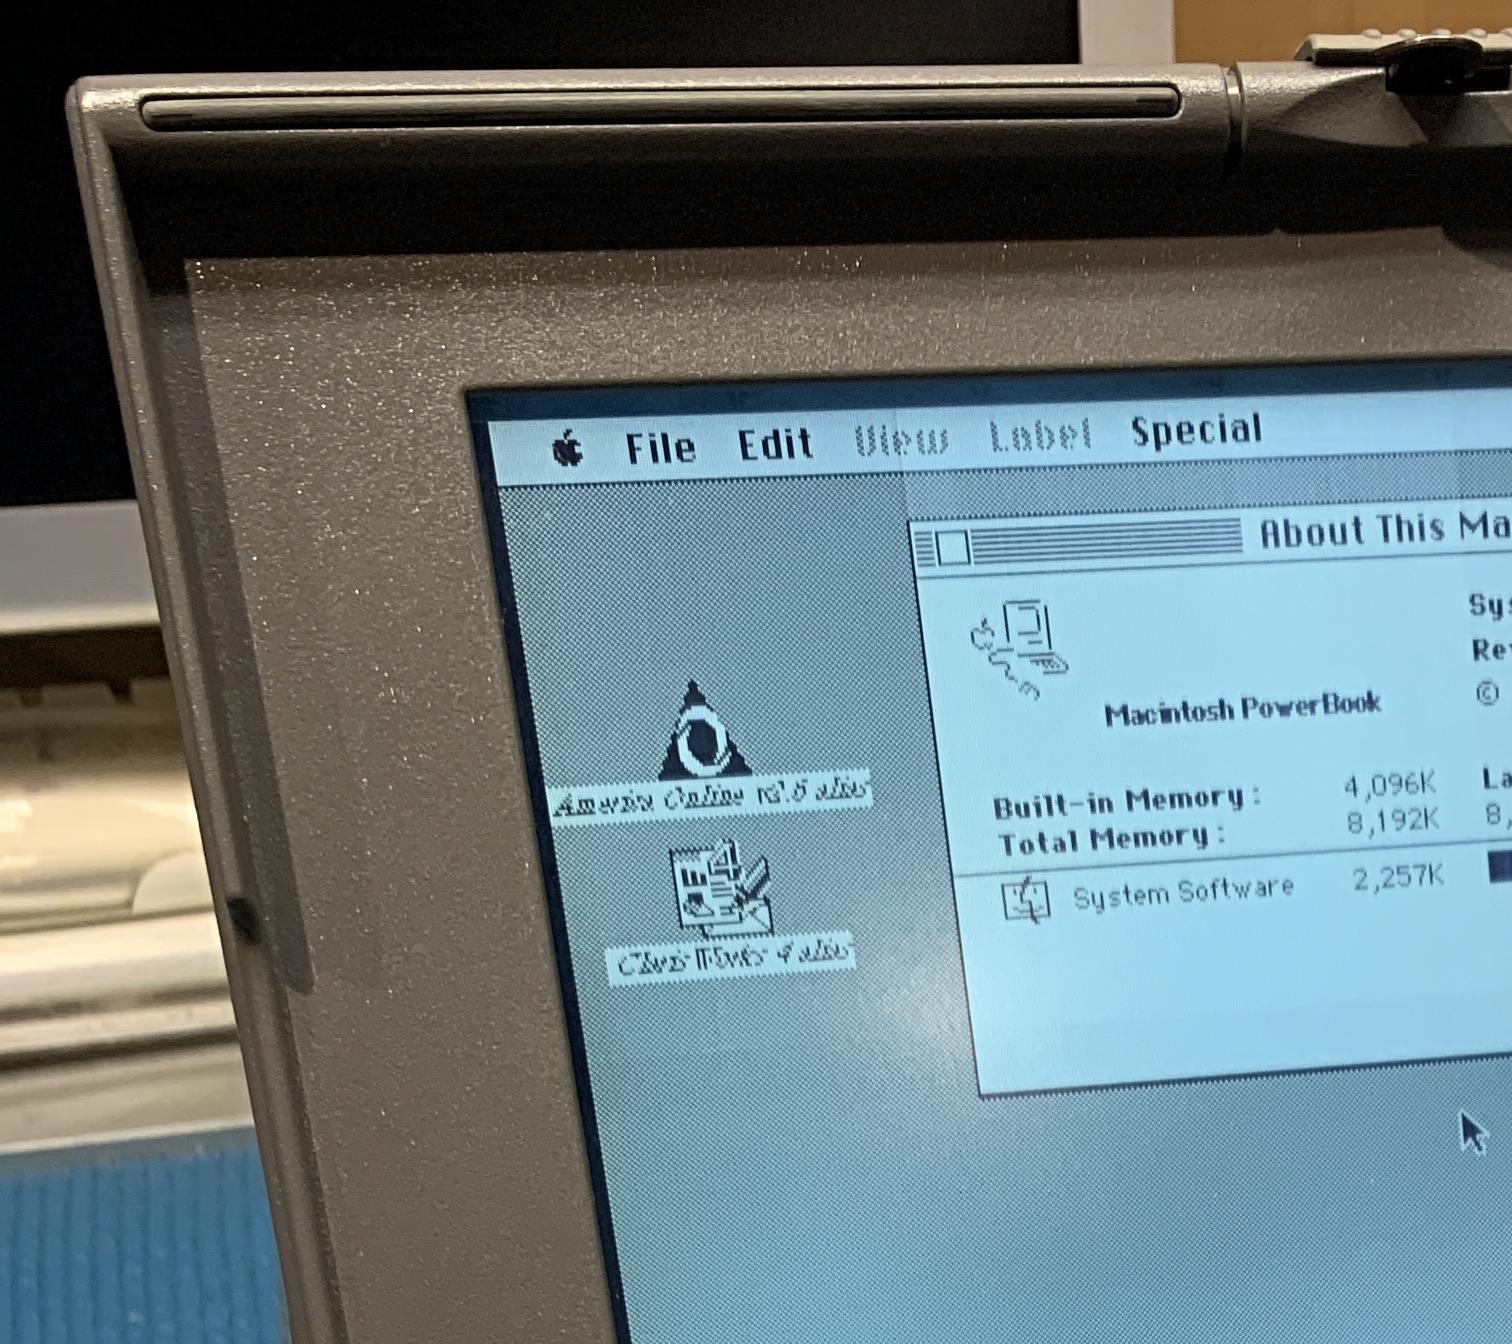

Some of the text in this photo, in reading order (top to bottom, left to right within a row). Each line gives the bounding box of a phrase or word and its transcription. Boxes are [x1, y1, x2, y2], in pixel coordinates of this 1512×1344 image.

[626, 412, 1263, 465] File Edit View Label Special
[1260, 516, 1363, 548] About
[1376, 513, 1444, 542] This
[1104, 689, 1382, 728] Macintosh PowerBook
[1344, 769, 1437, 803] 4,096K
[993, 792, 1113, 821] Built-in
[1347, 806, 1441, 839] 8,192K
[999, 829, 1079, 858] Total
[1074, 877, 1295, 914] System Software
[1353, 863, 1445, 896] 2,257K
